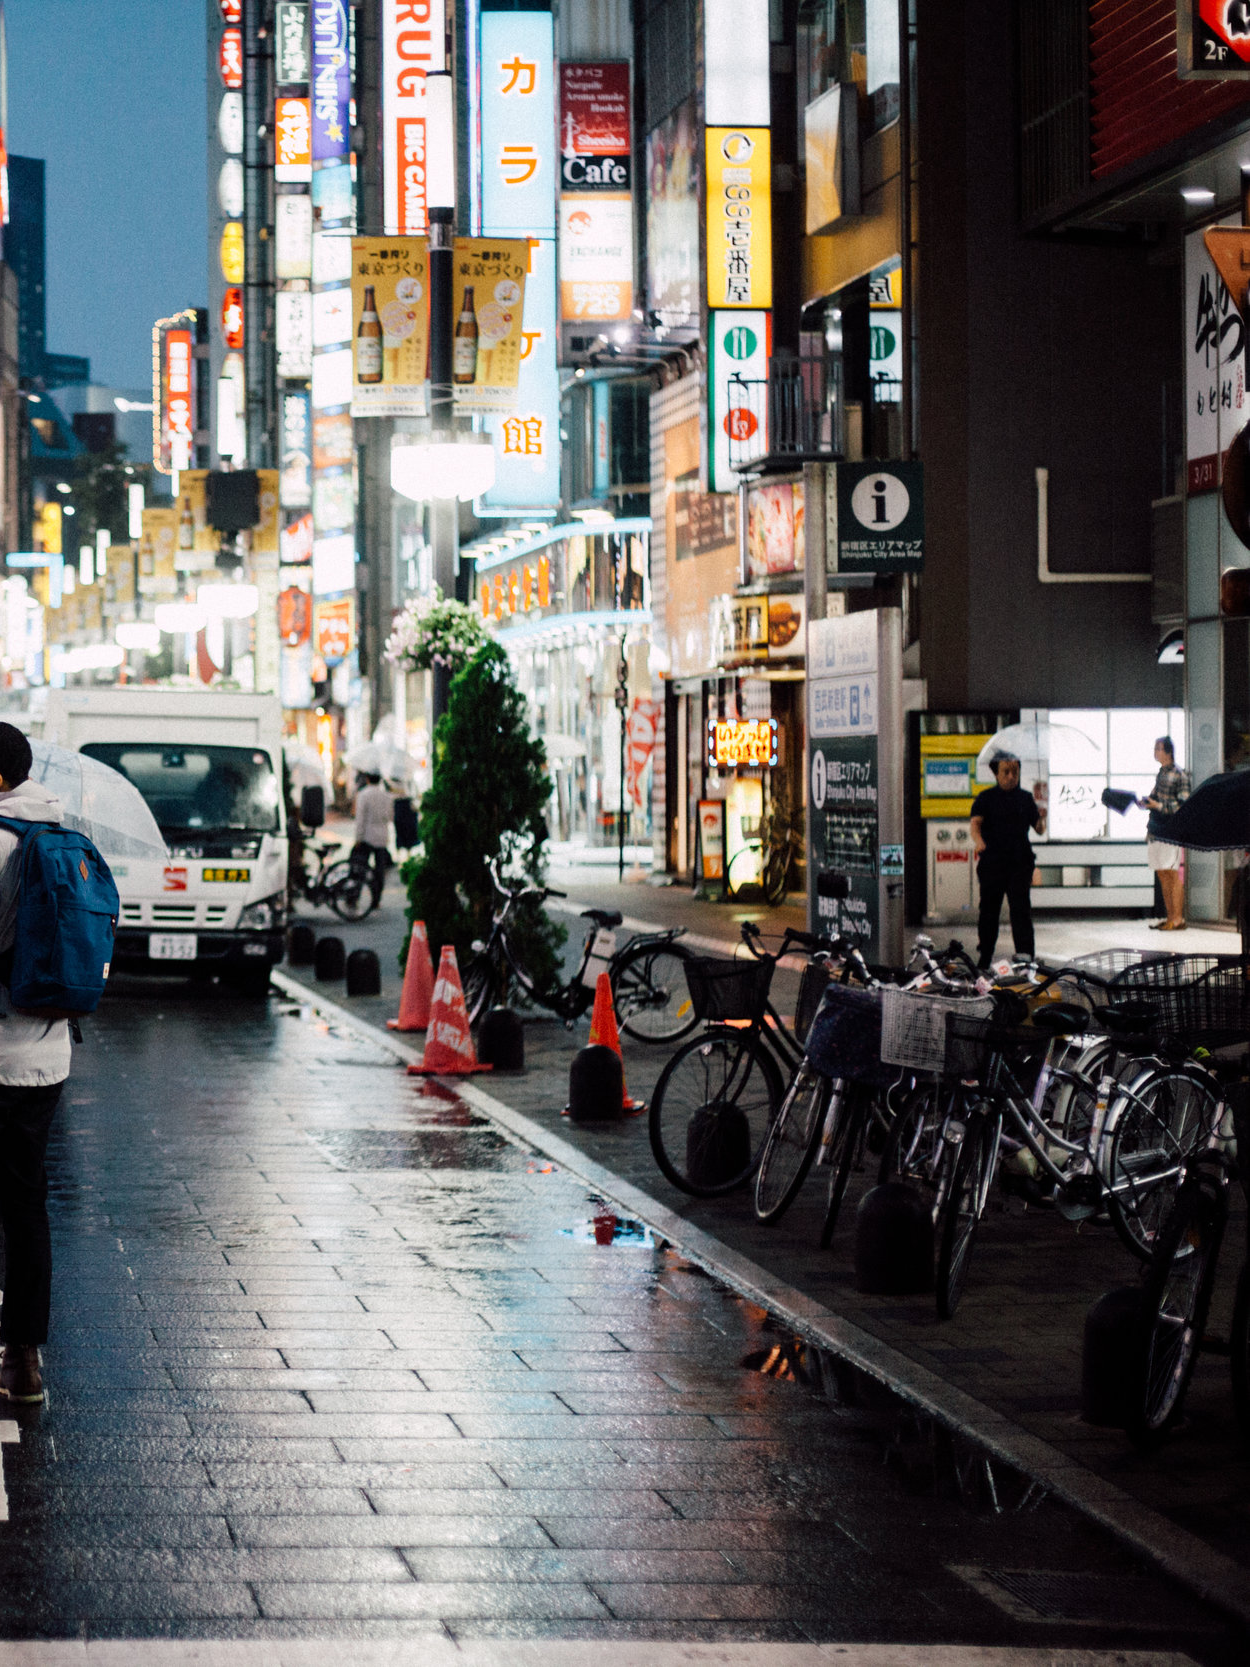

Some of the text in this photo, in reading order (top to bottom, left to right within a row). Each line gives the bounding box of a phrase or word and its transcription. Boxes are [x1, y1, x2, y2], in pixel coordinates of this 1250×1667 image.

[1205, 39, 1229, 60] 2F
[404, 124, 425, 234] BIC CAME
[562, 158, 626, 184] Cafe
[358, 263, 423, 276] 東京づくり
[460, 264, 524, 279] 東京づくり
[841, 540, 922, 550] 新宿区エリアマップ
[841, 551, 872, 559] Shinjuku
[873, 551, 888, 559] City
[907, 551, 922, 559] Map
[827, 761, 870, 782] 新宿区エリアマップ
[827, 784, 877, 803] Shinjuku City Area Map
